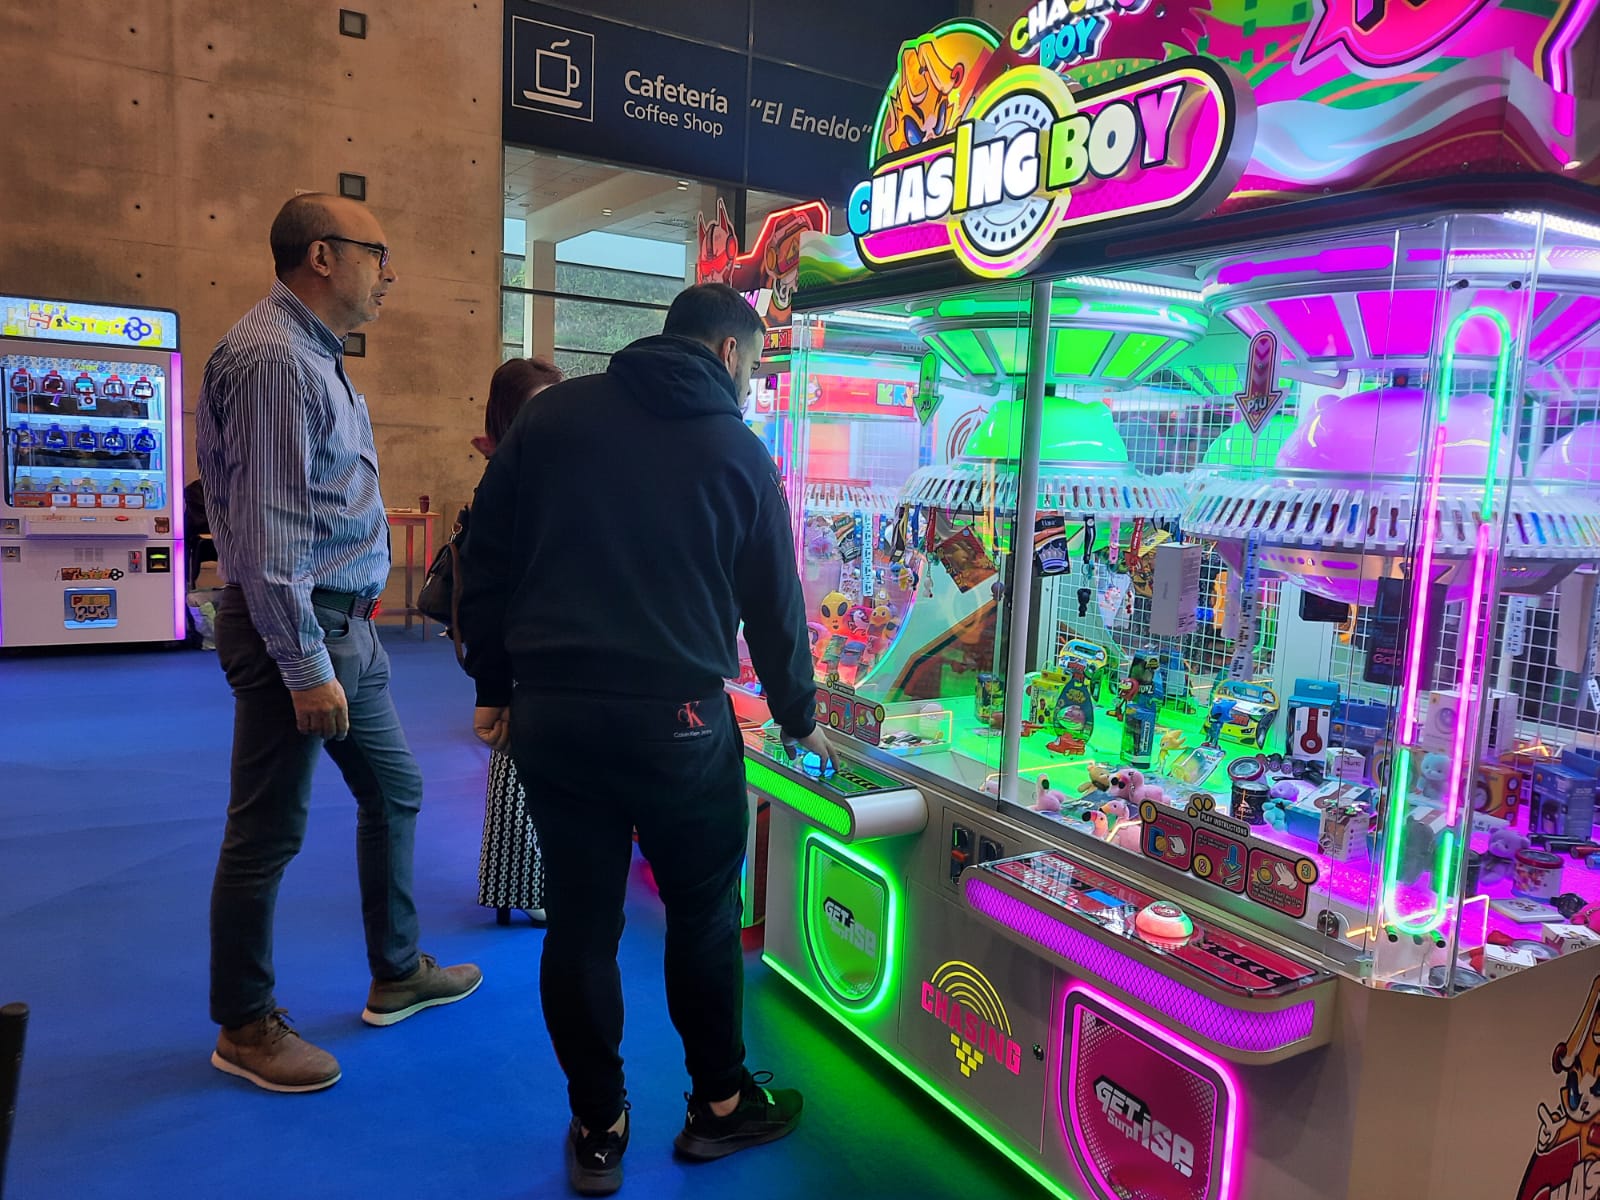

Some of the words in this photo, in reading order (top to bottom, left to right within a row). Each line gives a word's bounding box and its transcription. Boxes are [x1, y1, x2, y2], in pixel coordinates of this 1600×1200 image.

[1040, 15, 1098, 68] BOY
[624, 70, 729, 114] Cafetería
[623, 100, 679, 127] Coffee
[683, 113, 724, 138] Shop
[847, 118, 1041, 237] CHASING
[1045, 81, 1187, 192] BOY
[825, 901, 850, 927] GET
[921, 981, 1022, 1076] CHASING
[1095, 1080, 1142, 1122] GET
